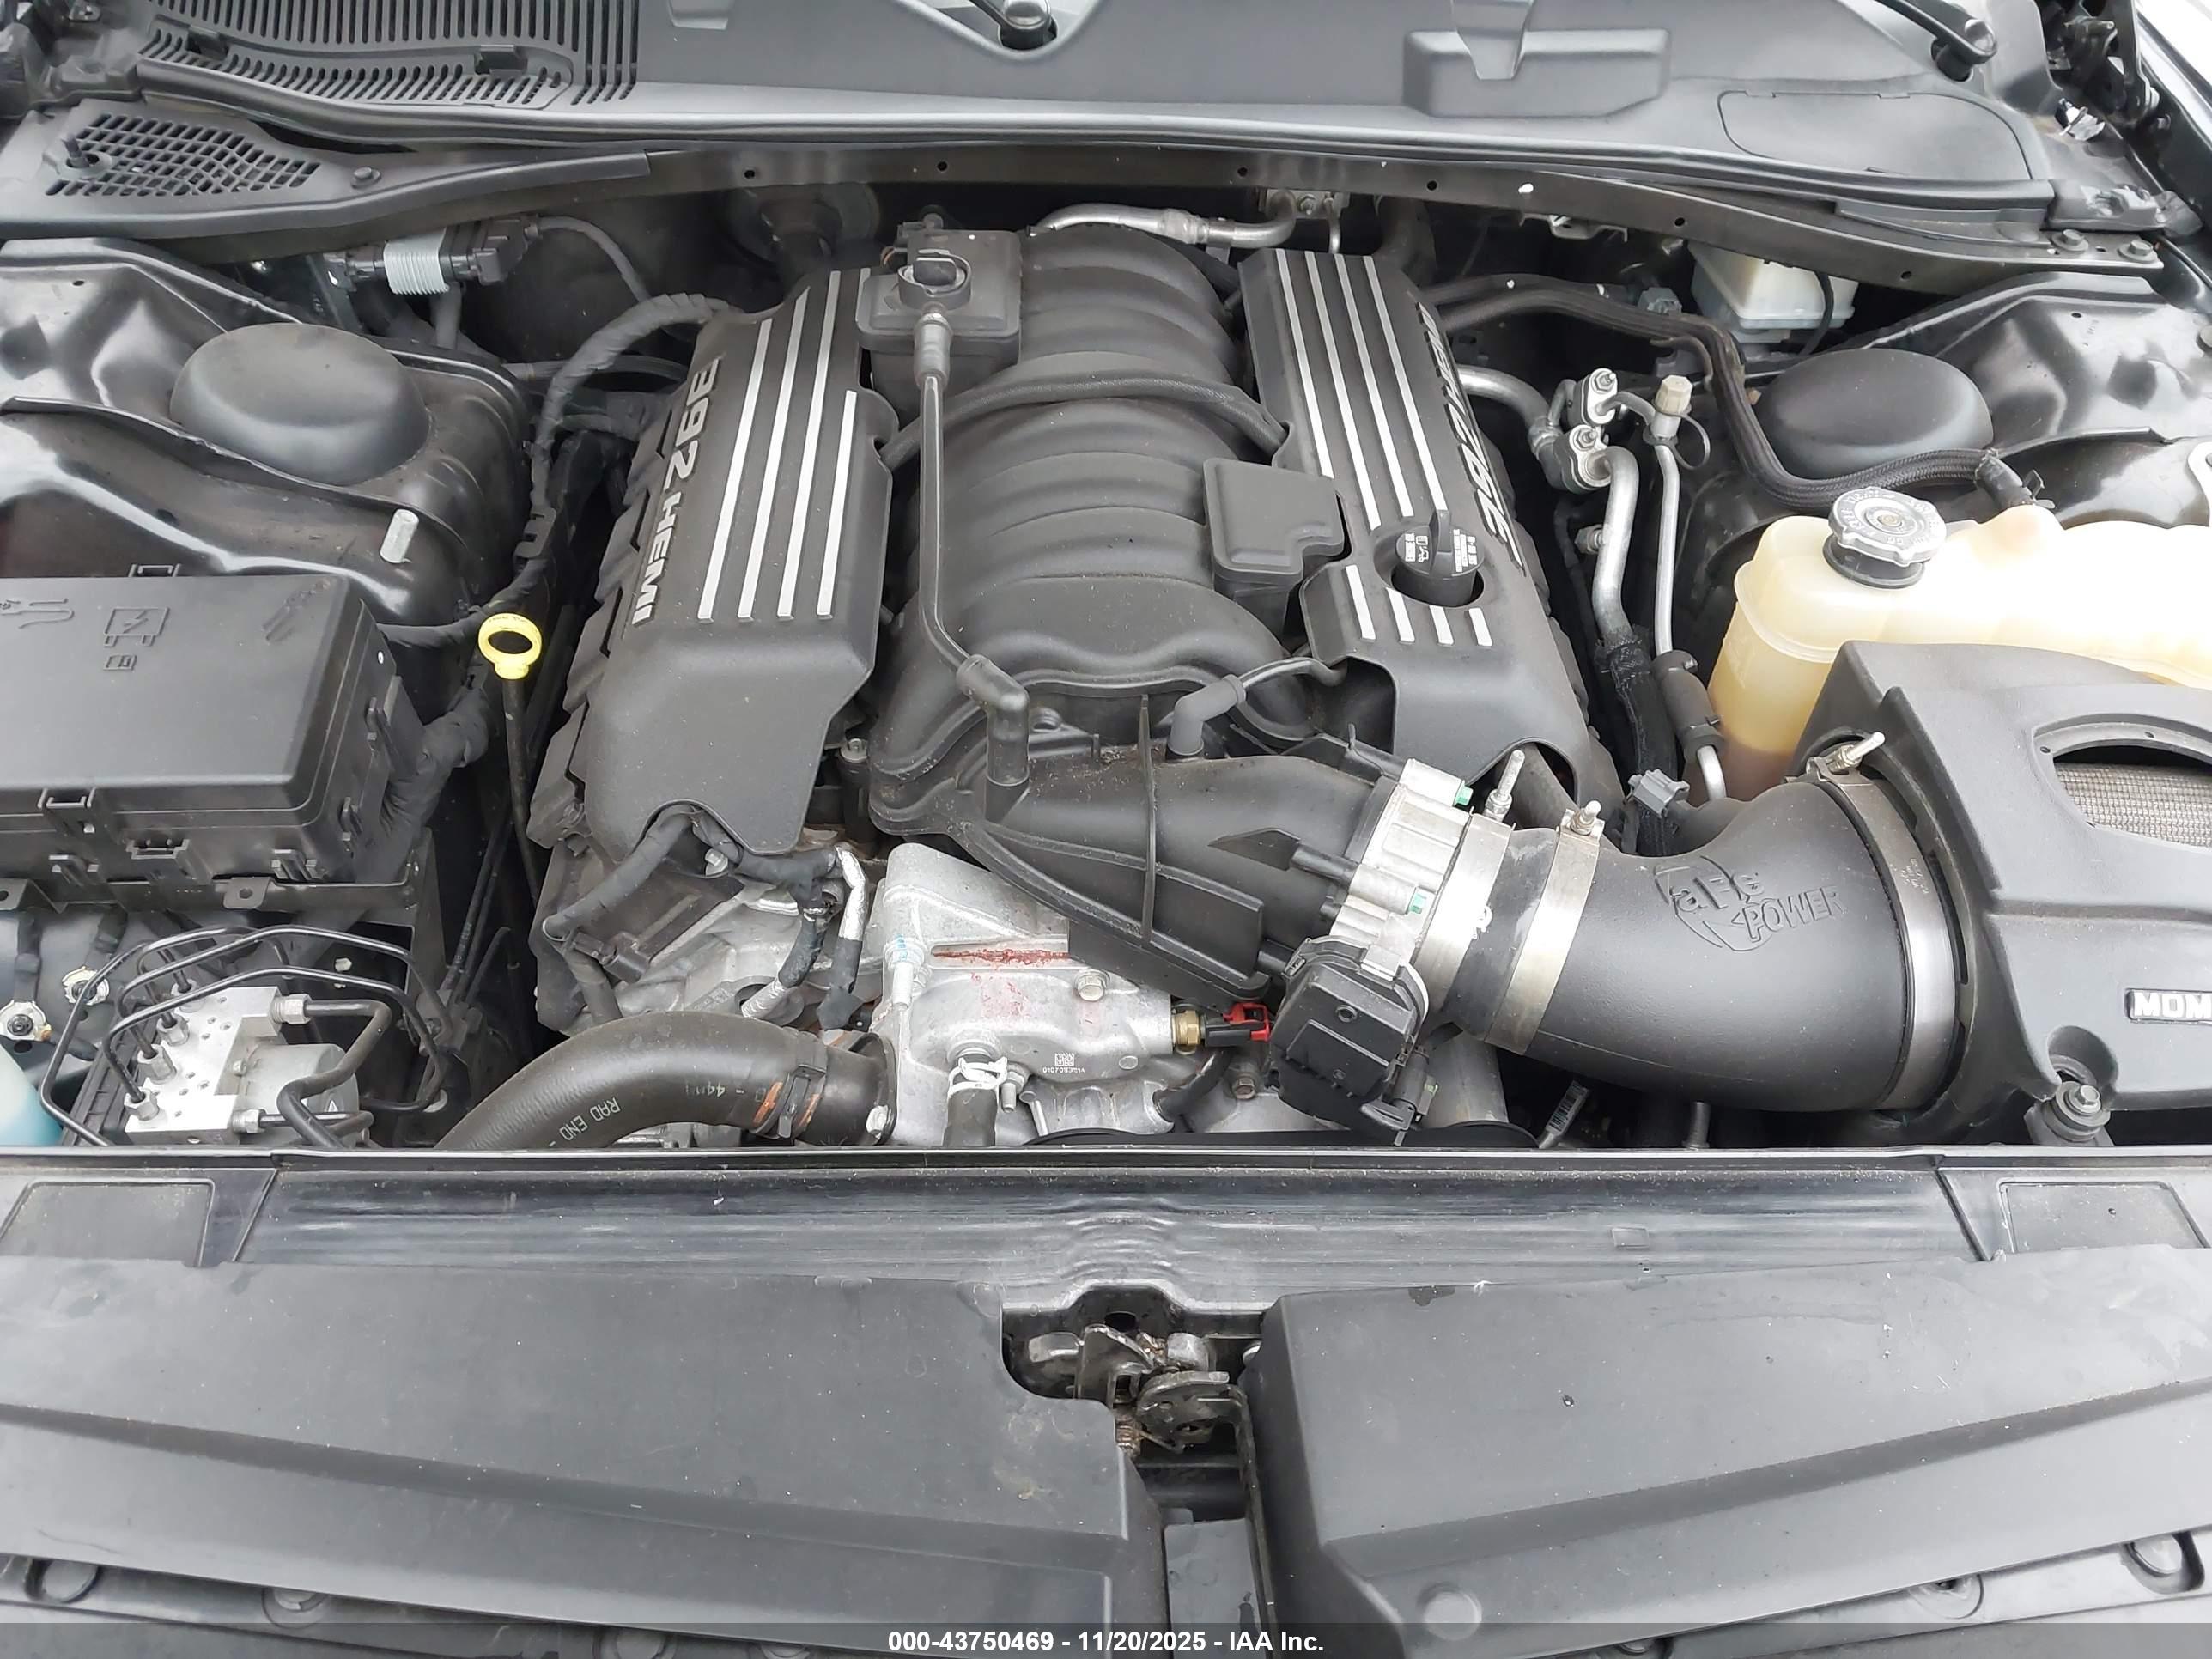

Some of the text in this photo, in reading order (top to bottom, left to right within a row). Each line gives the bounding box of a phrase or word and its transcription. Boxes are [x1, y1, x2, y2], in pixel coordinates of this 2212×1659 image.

[1418, 302, 1523, 568] 392 HEMI
[632, 358, 720, 625] 392 HEMI
[1742, 884, 1844, 943] POWER
[2133, 990, 2212, 1019] MOM
[559, 1115, 589, 1141] END
[589, 1097, 622, 1122] RAD
